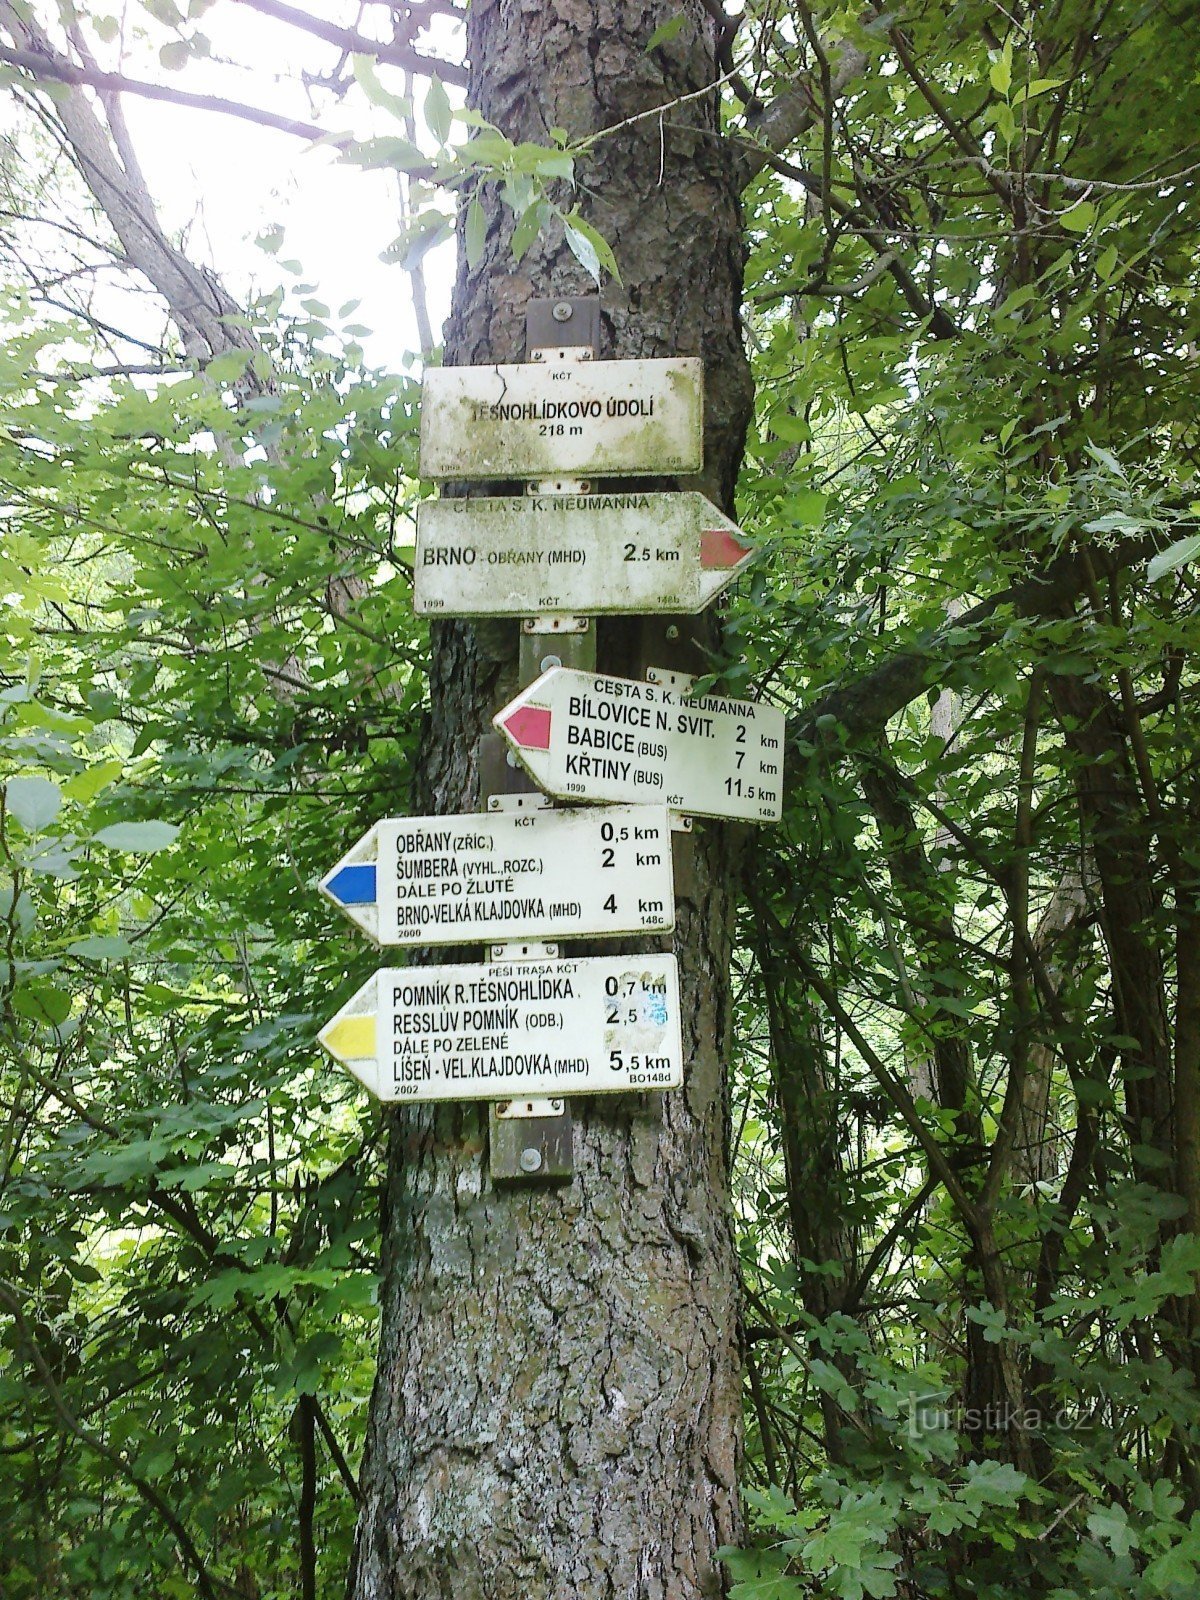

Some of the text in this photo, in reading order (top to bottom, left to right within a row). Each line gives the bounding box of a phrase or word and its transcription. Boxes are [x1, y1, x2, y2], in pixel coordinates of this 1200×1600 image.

[552, 372, 572, 380] KČT
[606, 395, 654, 417] ÚDOLÍ
[540, 424, 582, 436] 218 m
[532, 499, 547, 512] K.
[553, 496, 650, 512] NEUMANNA
[424, 548, 476, 566] BRNO
[488, 548, 544, 564] OBŘANY
[548, 550, 586, 566] (MHD)
[624, 544, 680, 561] 2.5 km
[539, 597, 560, 606] KČT
[594, 680, 756, 719] CESTA S. K. NEUMANNA
[569, 694, 716, 739] BÍLOVICE N. SVIT.
[568, 725, 668, 762] BABICE (BUS)
[736, 724, 778, 748] 2 km
[566, 752, 664, 790] KŘTINY (BUS)
[736, 751, 778, 775] 7 km
[566, 784, 586, 792] 1999
[724, 778, 776, 802] 11.5 km
[666, 794, 684, 805] KČT
[514, 818, 536, 827] KČT
[759, 808, 776, 818] 148a
[396, 829, 494, 854] OBŘANY (ZŘÍC.)
[600, 822, 659, 844] 0,5 km
[396, 856, 458, 880] ŠUMBERA
[602, 848, 661, 868] 2 km
[397, 877, 514, 898] DÁLE PO ŽLUTÉ
[398, 898, 582, 926] BRNO-VELKÁ KLAJDOVKA (MHD)
[603, 894, 664, 914] 4 km
[640, 916, 664, 925] 148c
[398, 930, 421, 938] 2000
[516, 965, 552, 976] TRASA
[557, 963, 578, 974] KČT
[394, 980, 450, 1007] POMNÍK
[605, 976, 666, 998] 0,7 km
[394, 1004, 564, 1034] RESSLŮV POMNÍK (ODB.)
[606, 1004, 638, 1026] 2,5
[394, 1032, 509, 1054] DÁLE PO ZELENÉ
[394, 1055, 430, 1082] LÍŠEŇ
[443, 1054, 552, 1079] VEL.KLAJDOVKA
[554, 1058, 589, 1078] (MHD)
[610, 1050, 671, 1073] 5,5 km
[630, 1073, 671, 1084] BO148d
[394, 1086, 418, 1095] 2002
